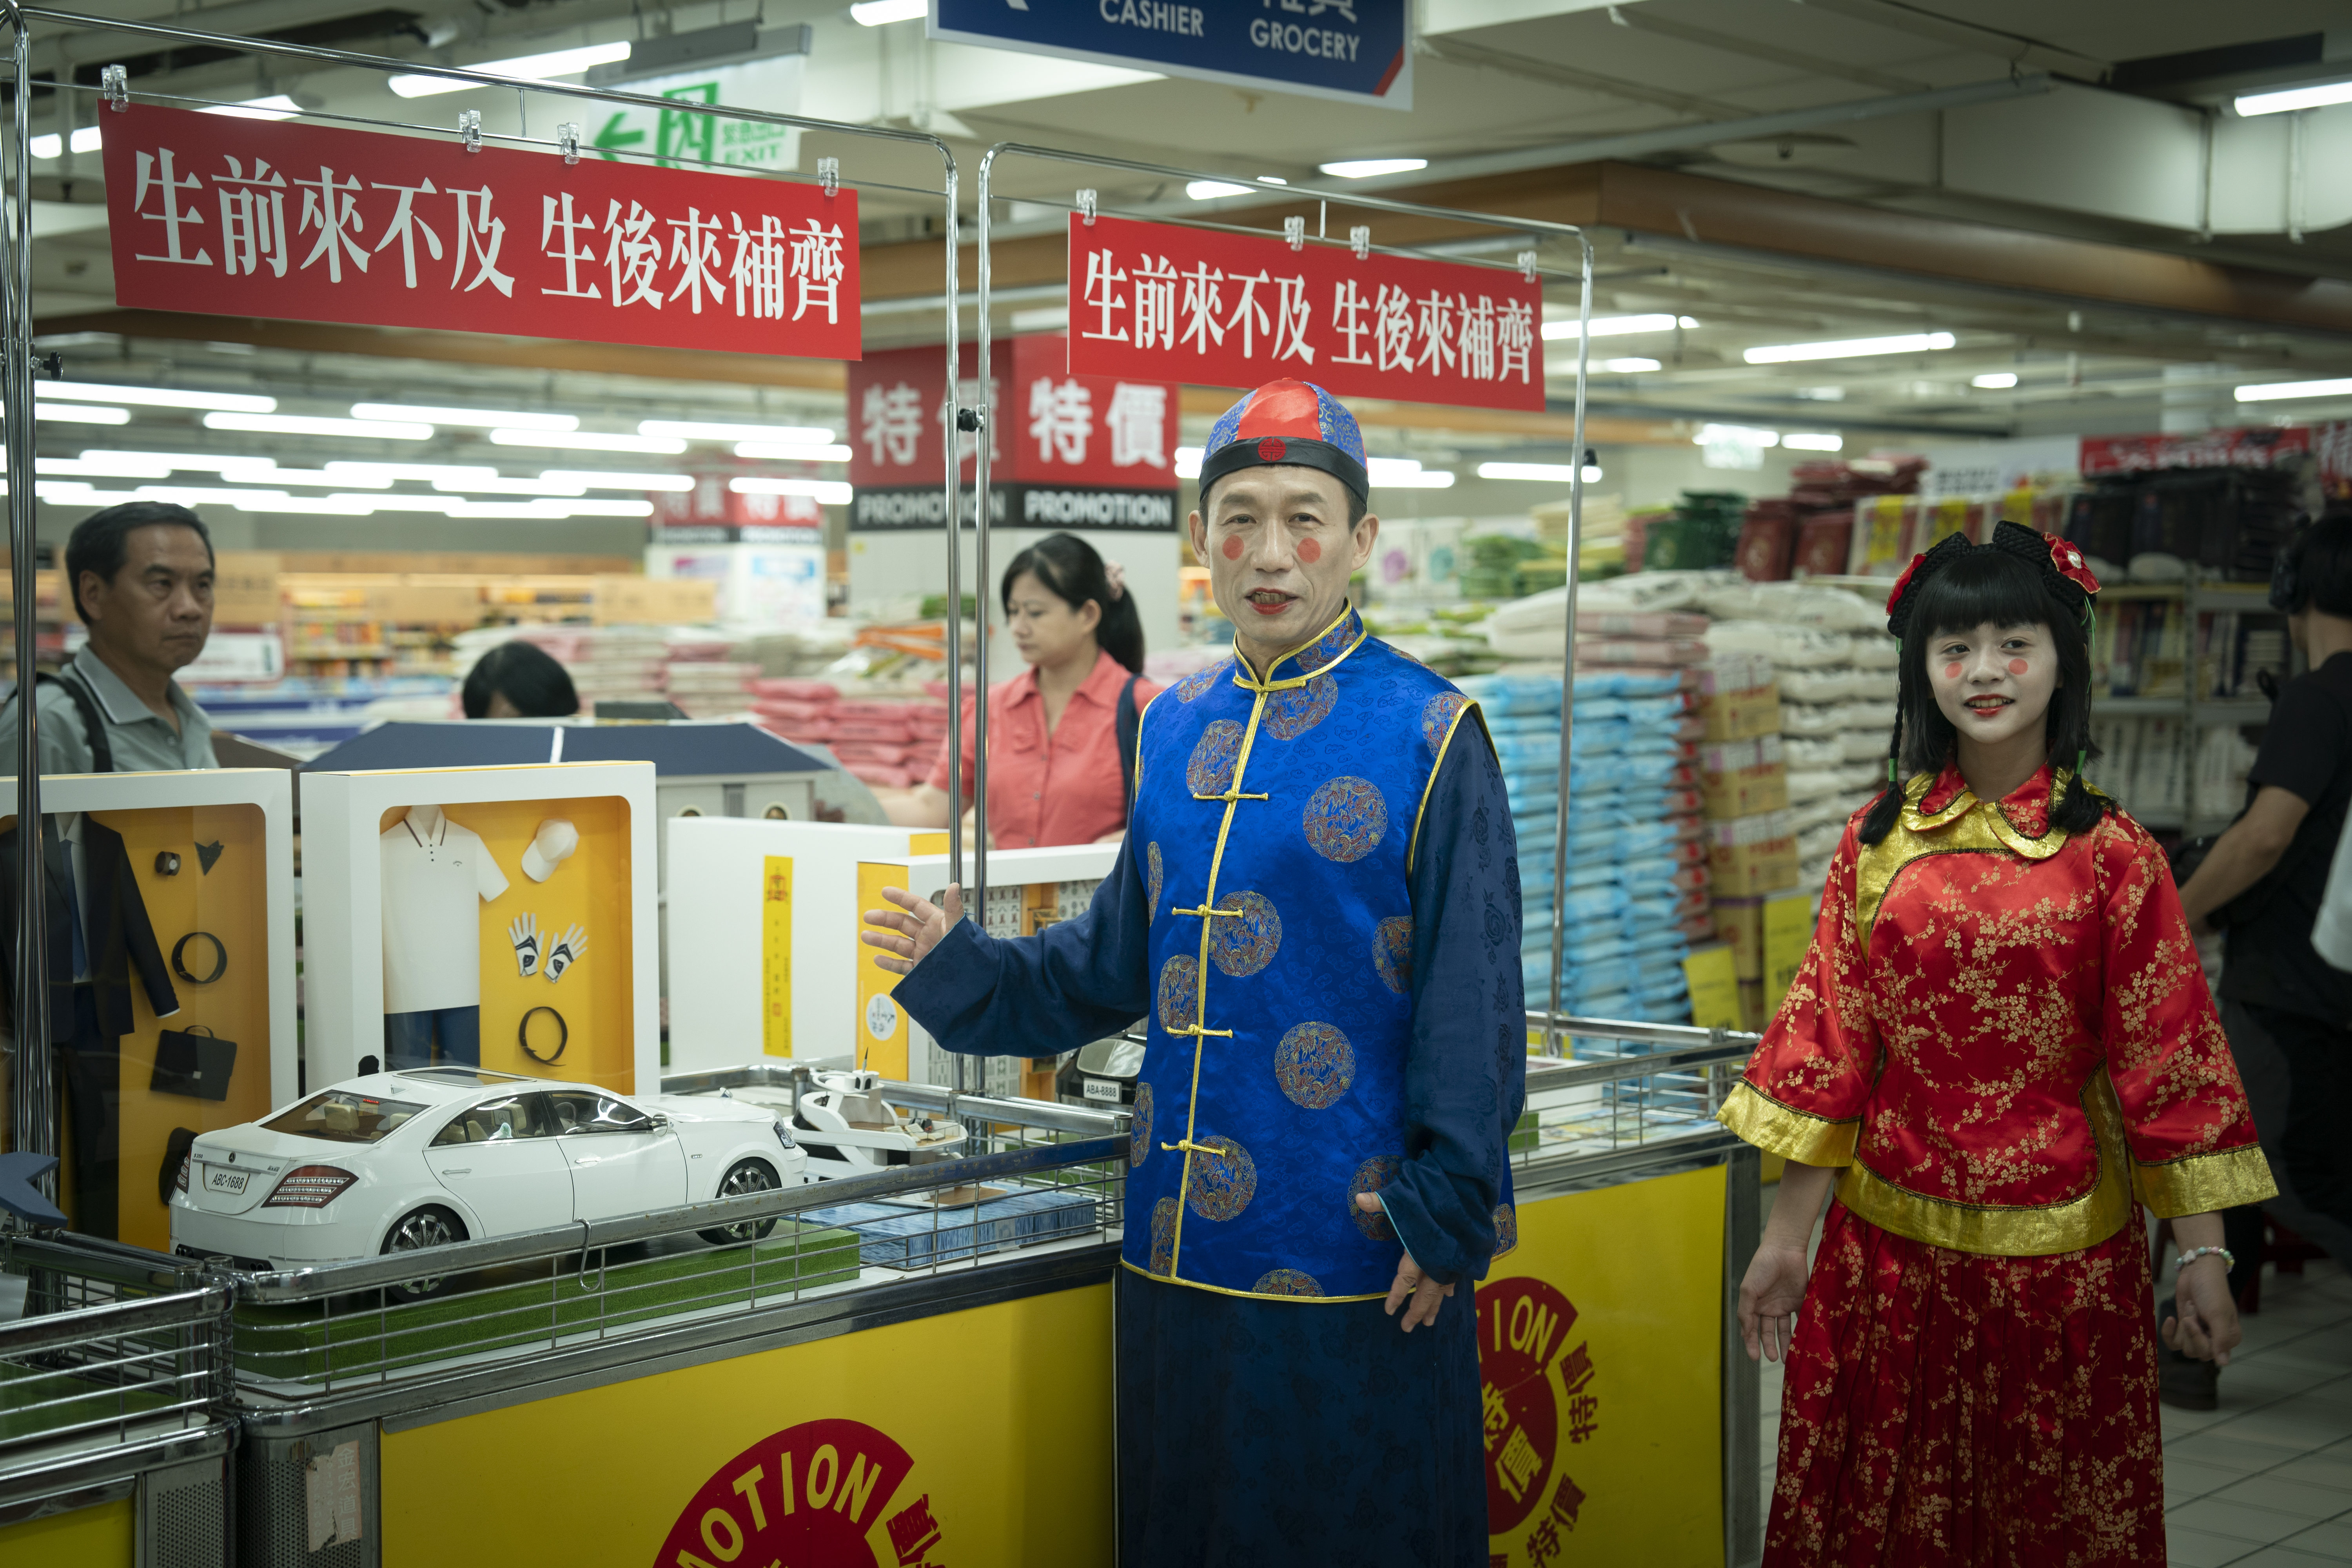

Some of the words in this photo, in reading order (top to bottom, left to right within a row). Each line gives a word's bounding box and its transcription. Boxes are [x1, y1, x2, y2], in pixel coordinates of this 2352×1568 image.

[1099, 0, 1204, 38] CASHIER
[1250, 18, 1360, 62] GROCERY
[724, 142, 781, 165] EXIT
[134, 147, 516, 299] 生前來不及
[541, 191, 845, 325] 生後來補齊
[1082, 247, 1316, 366] 生前來不及
[1330, 278, 1534, 385] 生後來補齊
[1029, 376, 1167, 470] 特價
[1024, 490, 1173, 526] PROMOTION
[1086, 1084, 1117, 1097] ABA-8888
[211, 1172, 245, 1190] ABC-1688
[337, 1447, 357, 1539] 金宏道具
